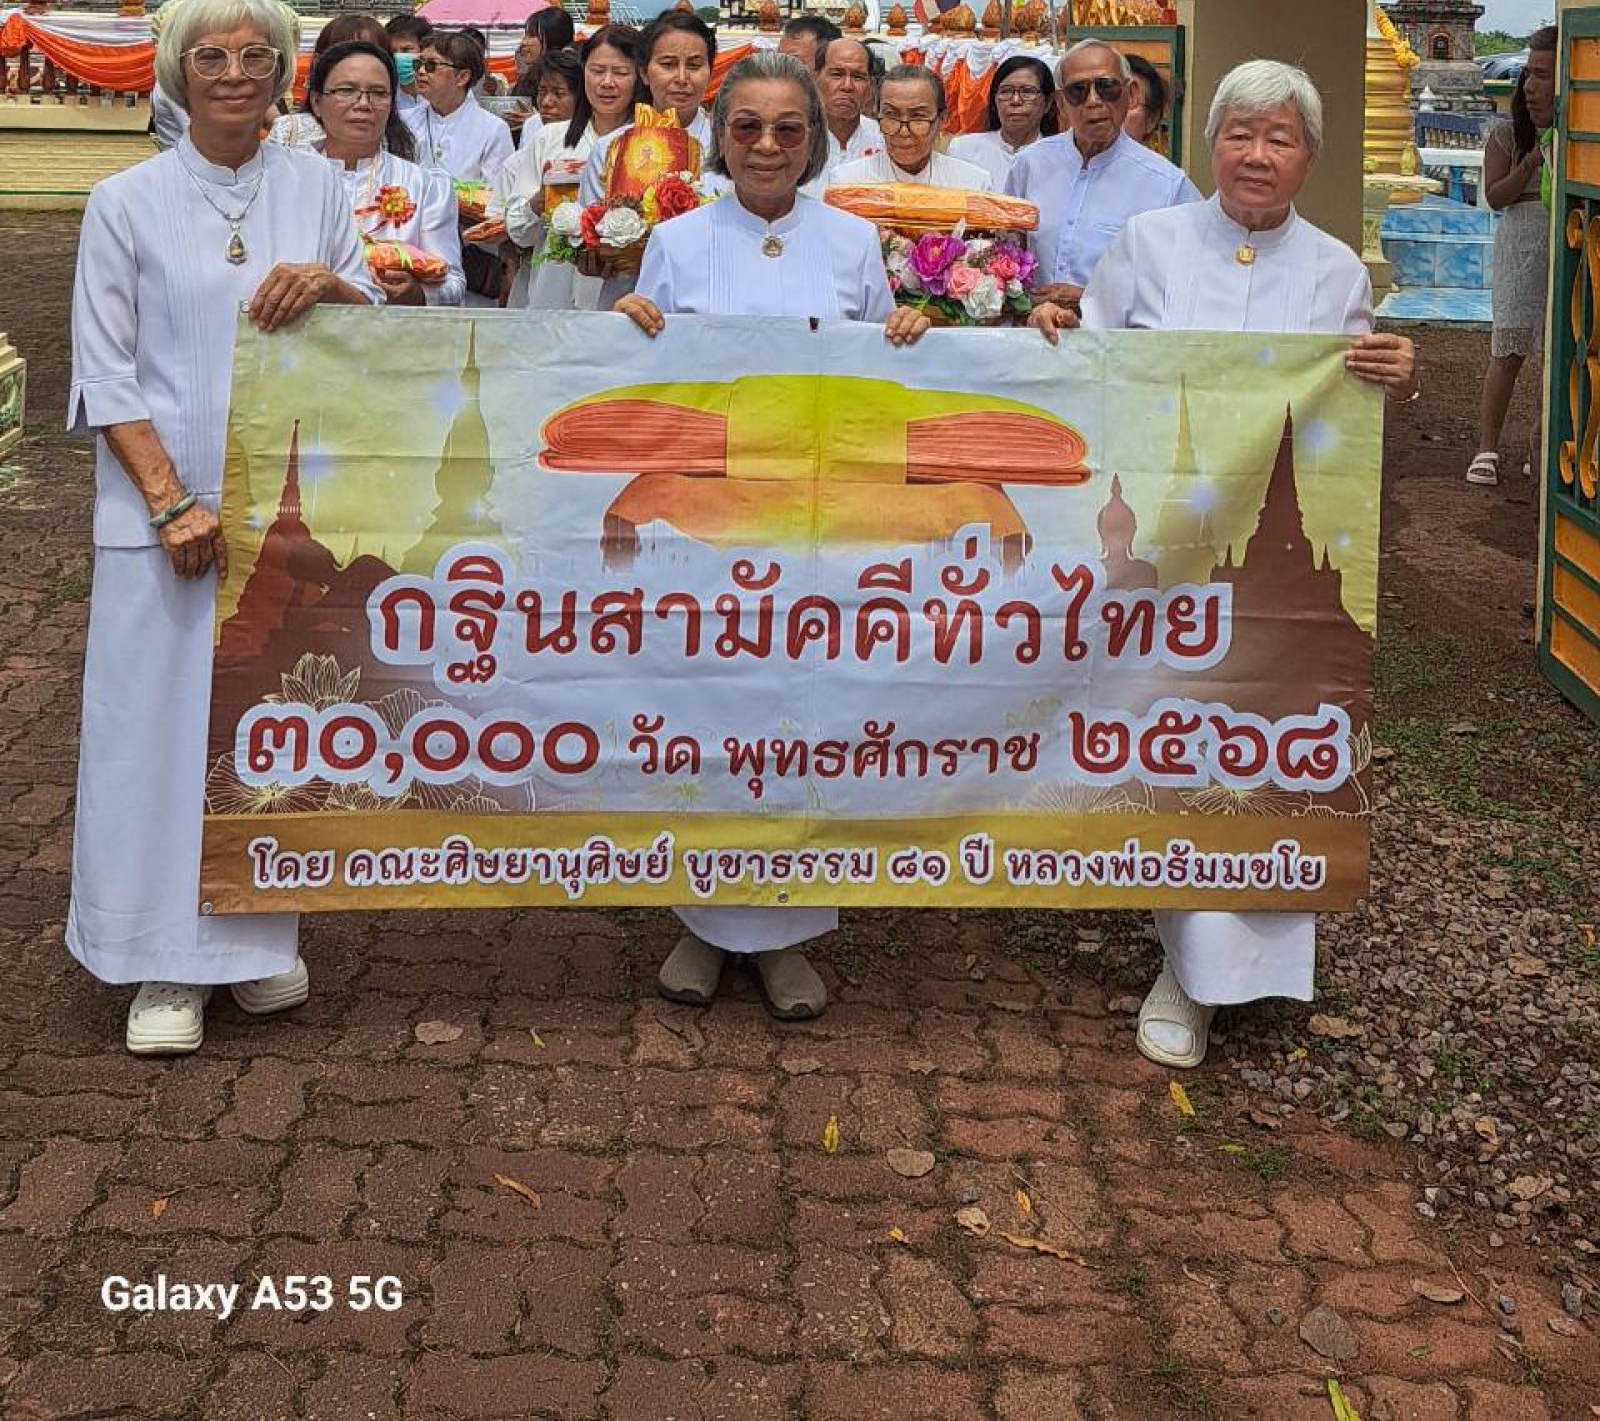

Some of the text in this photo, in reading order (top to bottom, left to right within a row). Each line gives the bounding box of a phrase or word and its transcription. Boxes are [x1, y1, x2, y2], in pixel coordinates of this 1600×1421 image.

[379, 535, 1220, 683] กฐินสามัคคีทั่วไทย
[248, 709, 1339, 799] ๓๐,๐๐๐ วัด พุทธศักราช ๒๕๖๘
[253, 836, 1322, 894] โดย คณะศิษยานุศิษย์ บูชาธรรม ๘๑ ปี หลวงพ่อธัมมชโย
